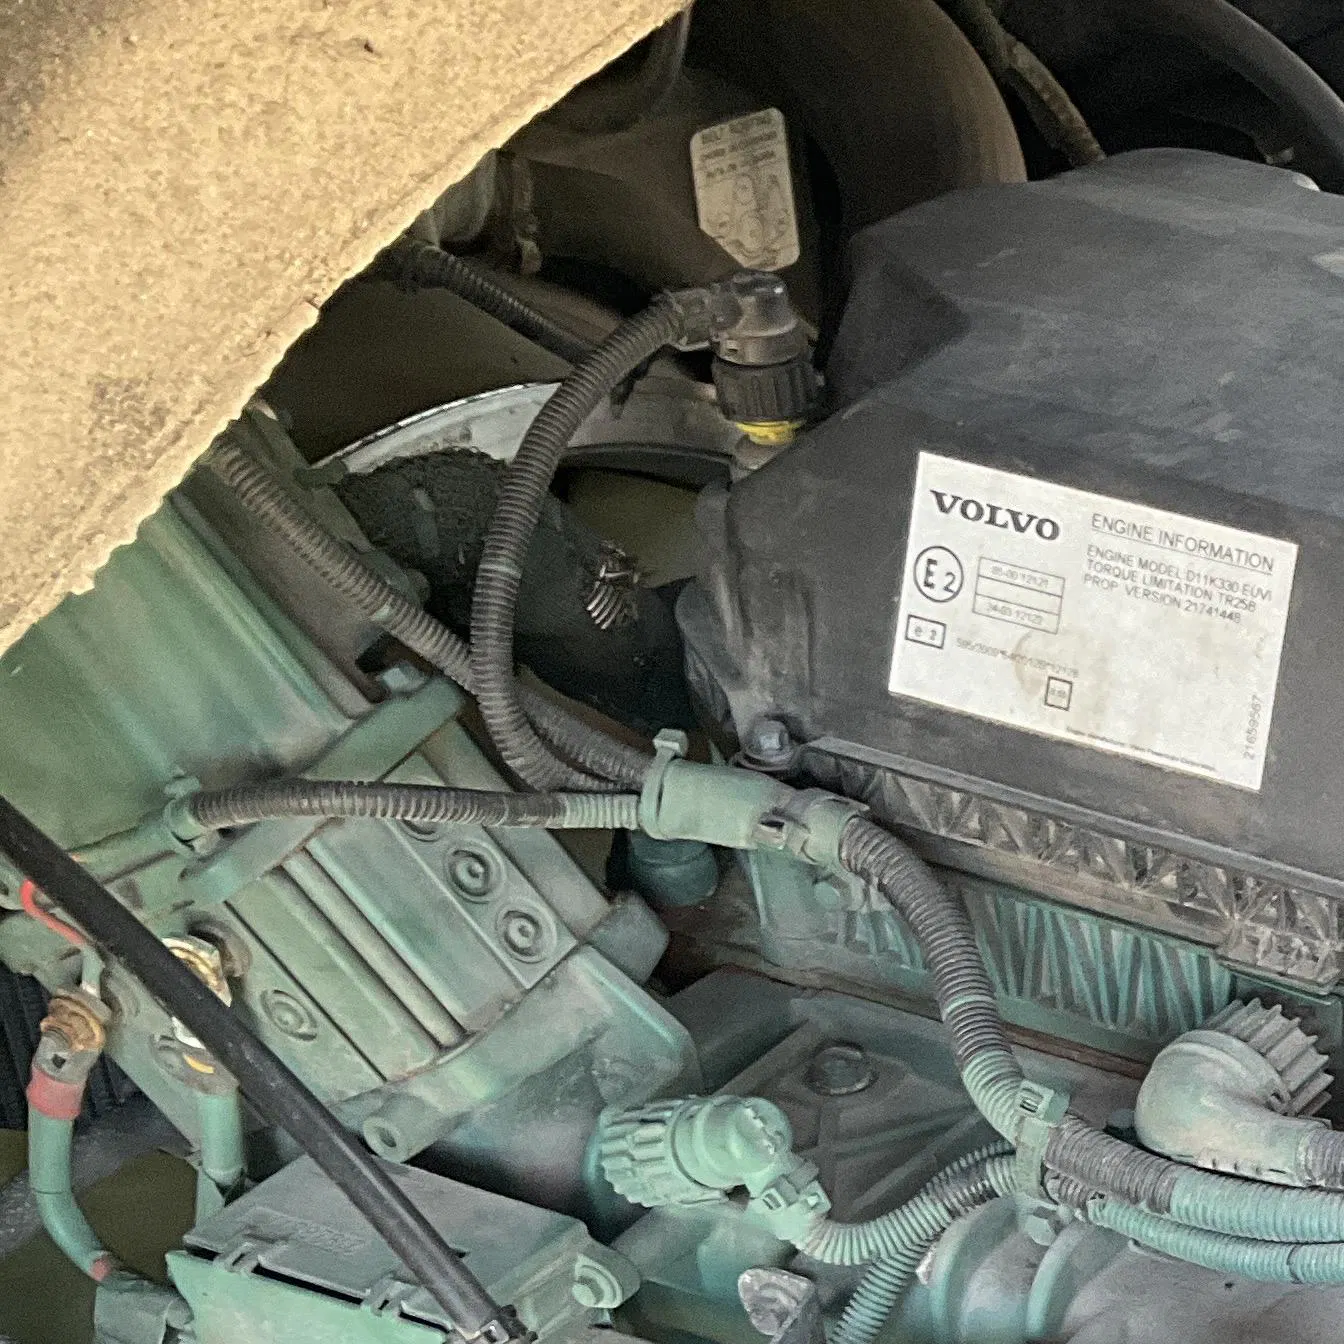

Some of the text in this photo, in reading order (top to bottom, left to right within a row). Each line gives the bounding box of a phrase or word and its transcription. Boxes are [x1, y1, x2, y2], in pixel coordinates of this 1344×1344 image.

[930, 489, 1060, 541] VOLVO
[1086, 544, 1134, 567] ENGINE
[1138, 557, 1182, 579] MODEL
[1091, 512, 1274, 572] ENGINE INFORMATION
[1086, 559, 1138, 583] TORQUE
[1142, 574, 1213, 600] LIMITATION
[1124, 584, 1181, 608] VERSION
